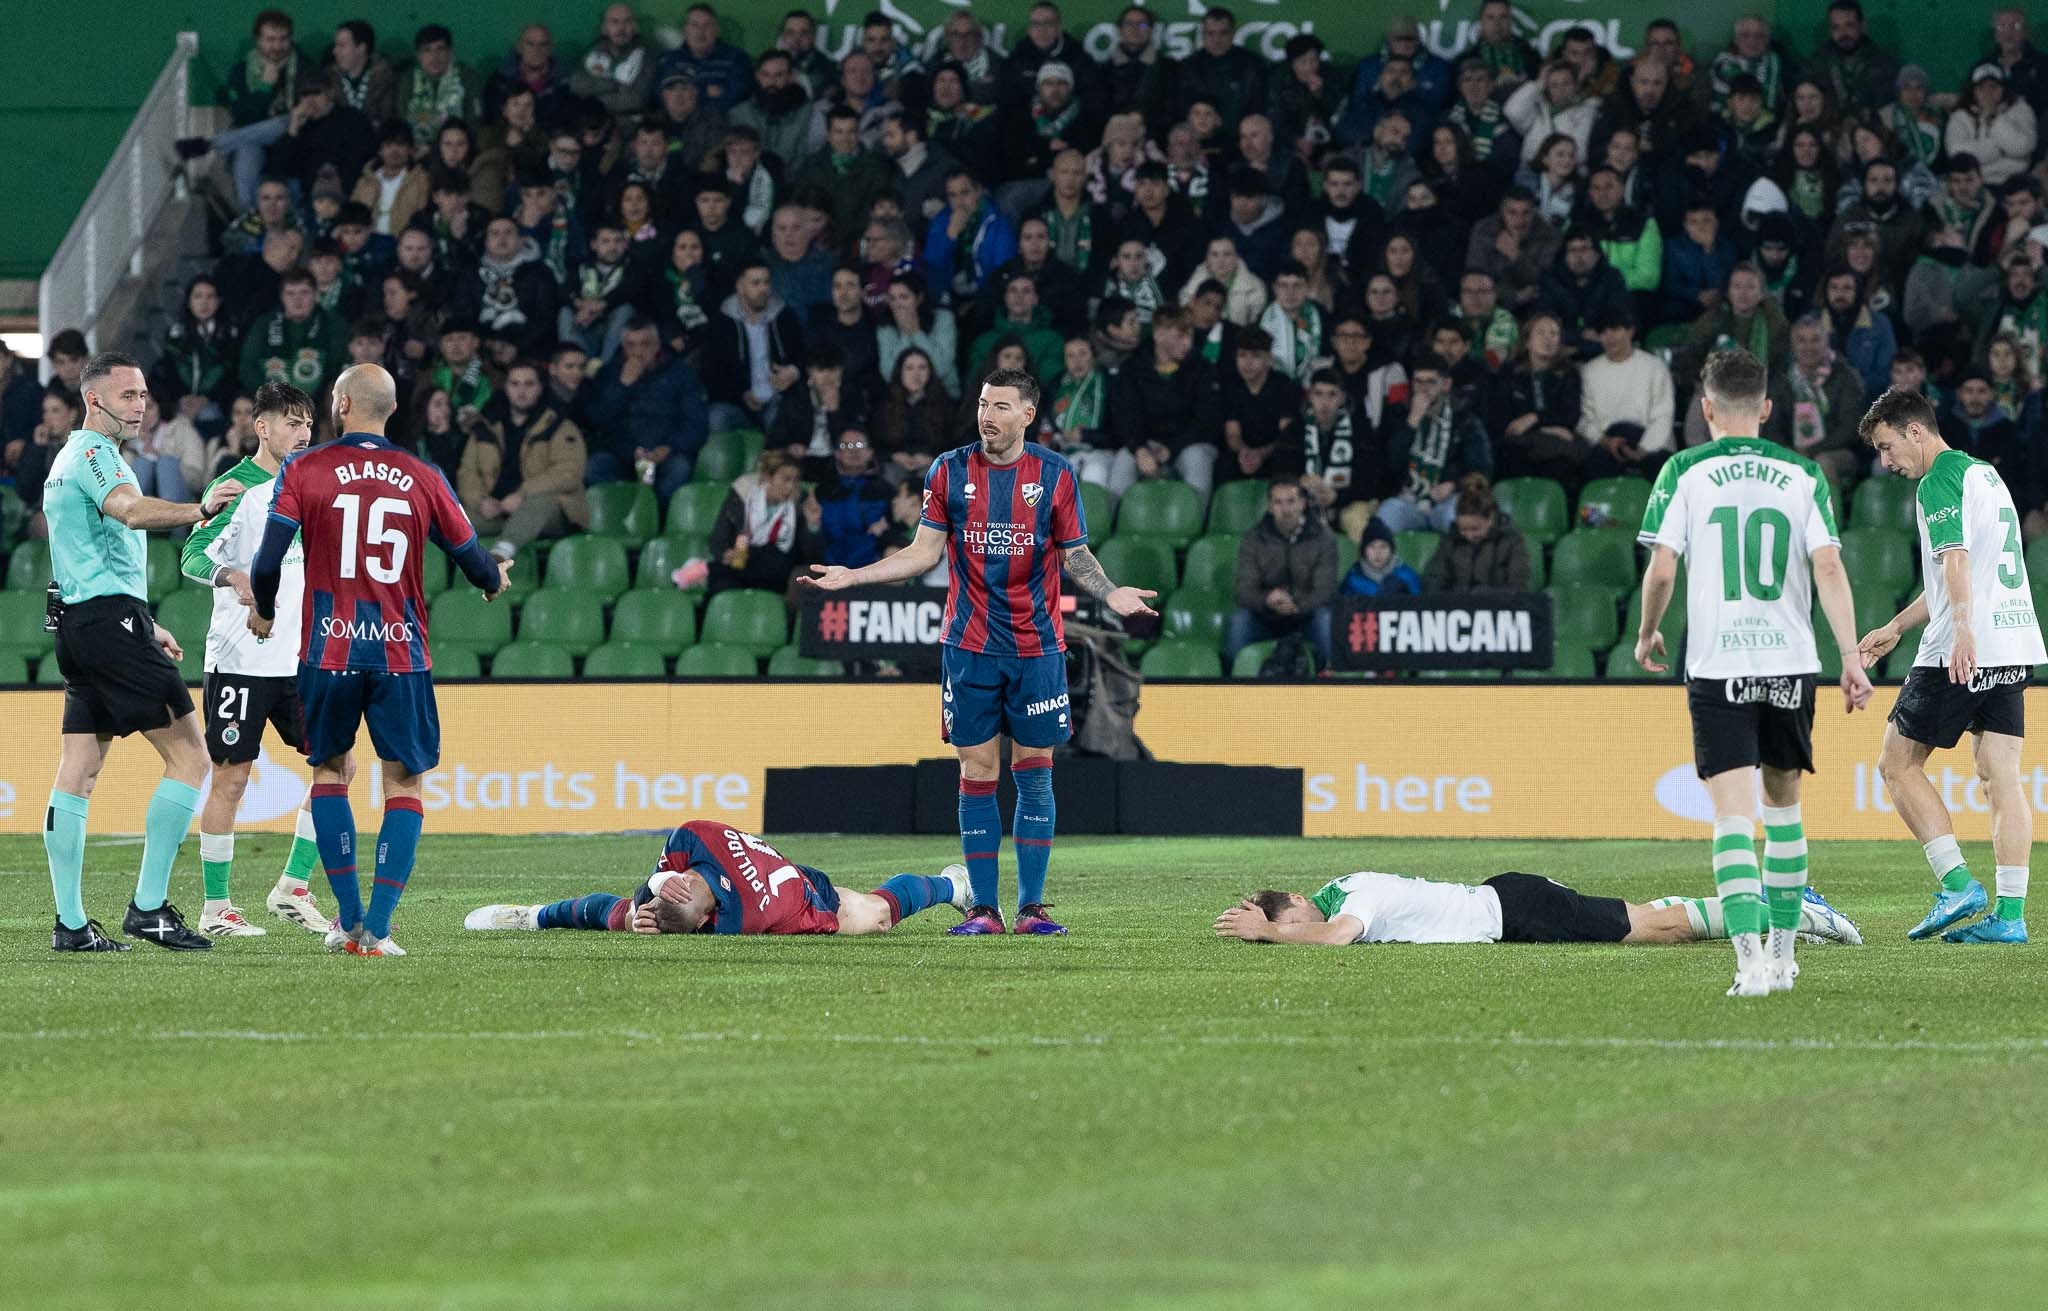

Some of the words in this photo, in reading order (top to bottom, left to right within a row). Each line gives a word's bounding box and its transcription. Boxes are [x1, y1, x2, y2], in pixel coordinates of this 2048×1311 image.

[334, 460, 414, 492] BLASCO
[1708, 460, 1793, 491] VICENTE
[332, 493, 412, 584] 15
[1707, 506, 1792, 601] 10
[1997, 507, 2024, 589] 3
[320, 617, 413, 642] SOMMOS
[818, 600, 945, 644] #FANC
[1348, 609, 1533, 653] #FANCAM
[1721, 632, 1788, 648] PASTOR
[218, 686, 249, 720] 21
[423, 764, 596, 809] starts
[614, 762, 750, 809] here
[1356, 762, 1491, 813] here
